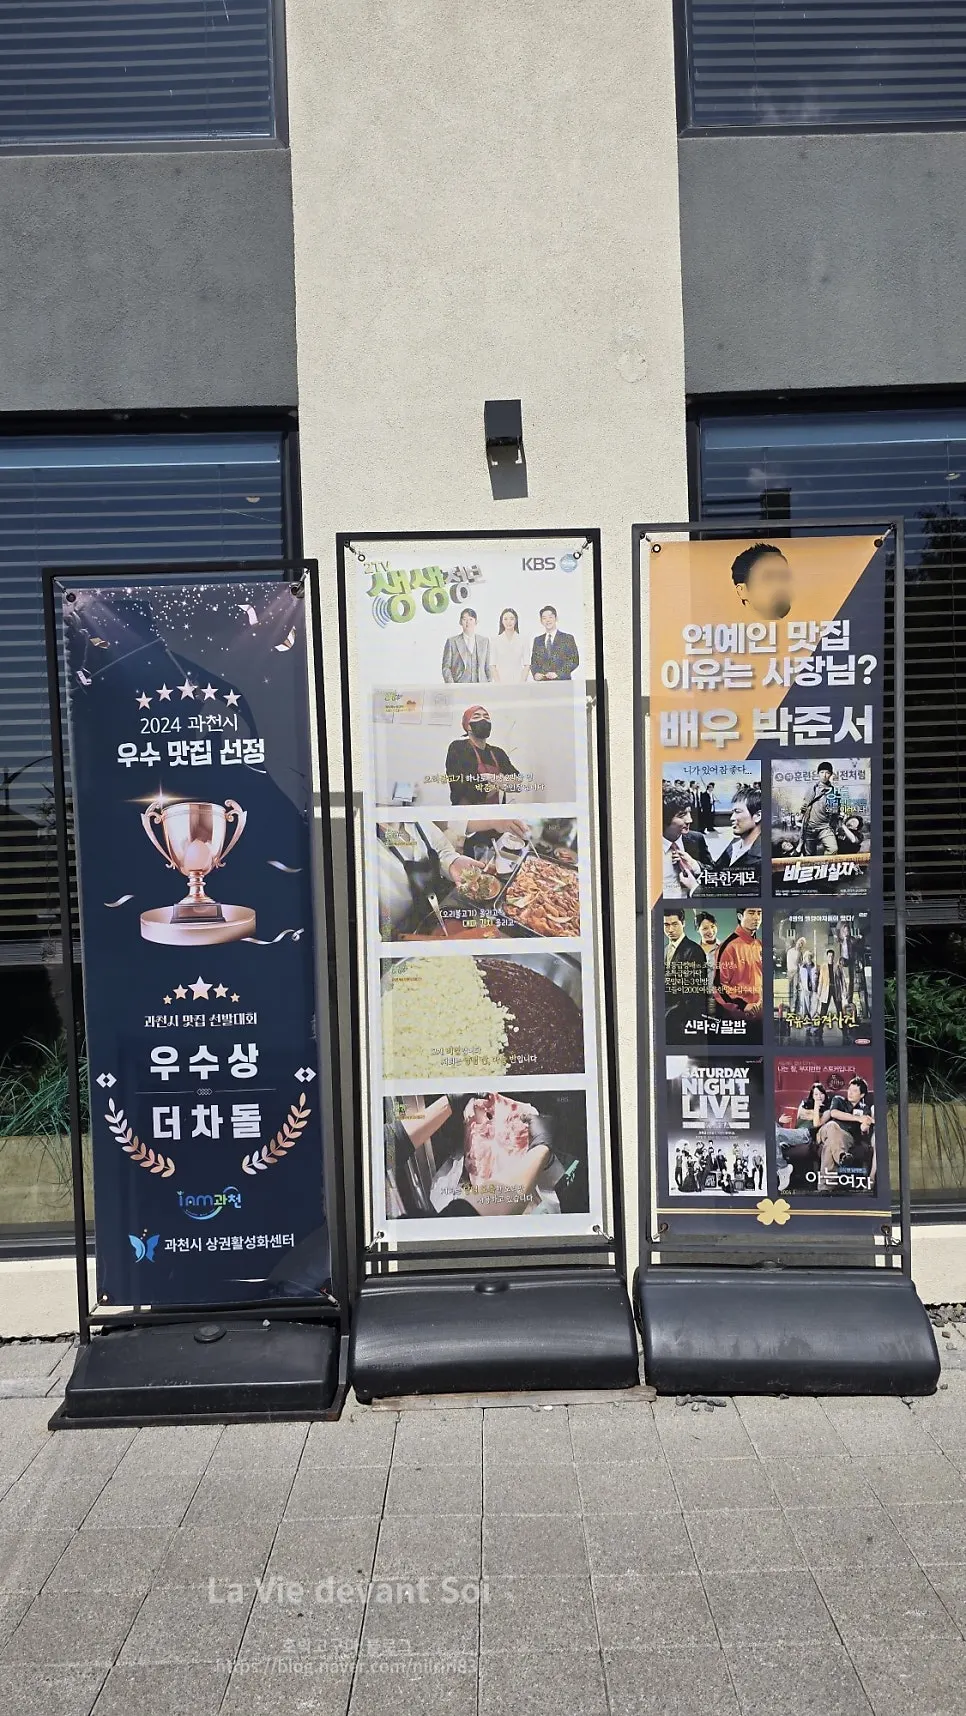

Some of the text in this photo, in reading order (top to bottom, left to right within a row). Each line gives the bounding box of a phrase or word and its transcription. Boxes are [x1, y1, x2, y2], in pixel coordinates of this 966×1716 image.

[522, 557, 556, 571] KBS
[682, 620, 850, 655] 연예인 맛집
[661, 655, 878, 690] 이유는 사장님?
[140, 714, 238, 734] 2024 과천시
[660, 705, 873, 748] 배우 박준서
[117, 738, 266, 768] 우수 맛집 선정
[683, 766, 700, 775] 니가
[144, 1012, 258, 1028] 과천시 맛집 선발대회
[150, 1043, 259, 1081] 우수상
[682, 1068, 749, 1078] SATURDAY
[681, 1078, 750, 1096] NIGHT
[682, 1095, 750, 1119] LIVE
[152, 1103, 262, 1140] 더차돌
[164, 1233, 295, 1252] 과천시 상권활성화센터
